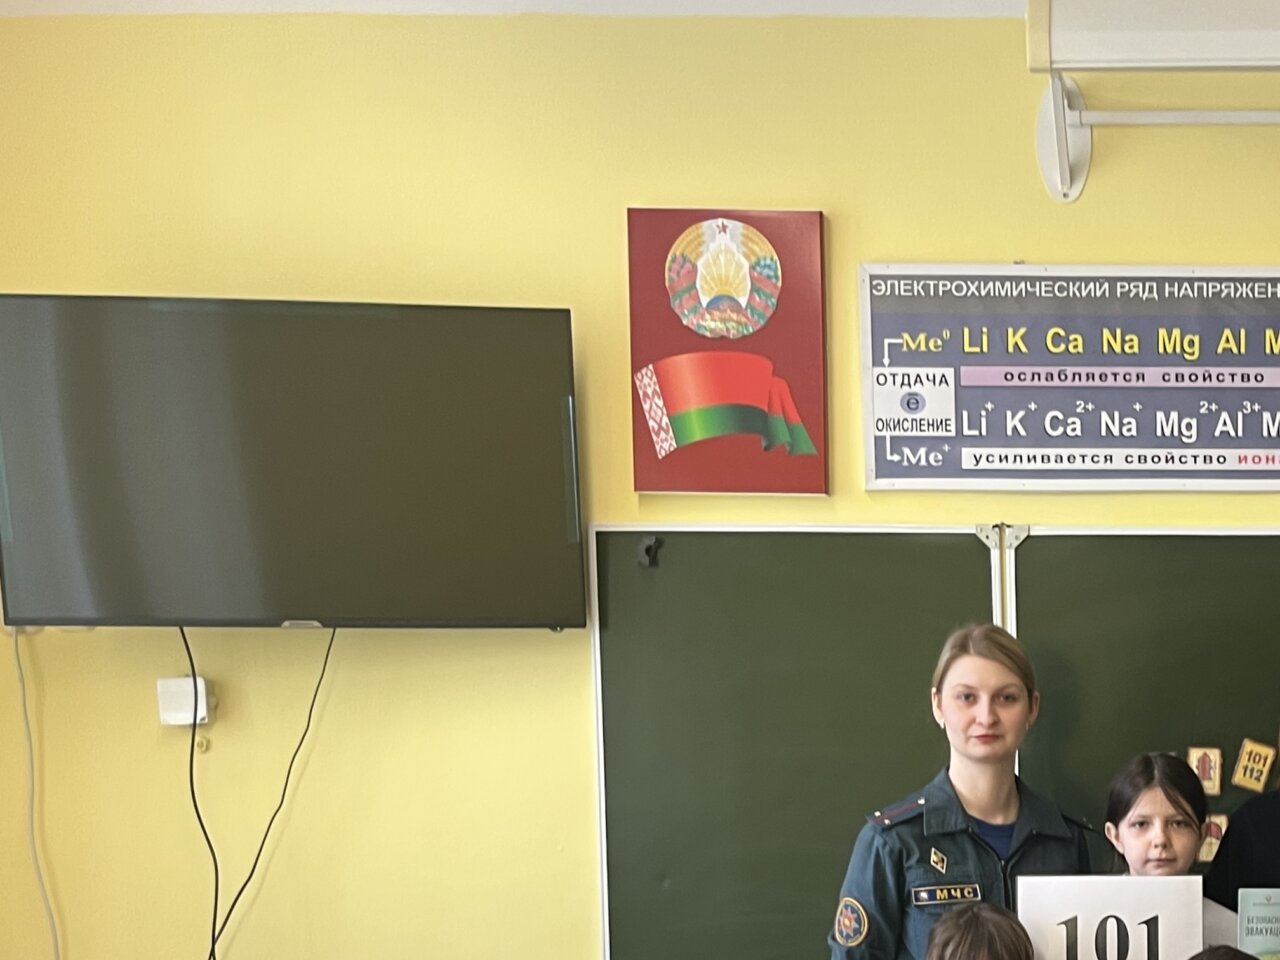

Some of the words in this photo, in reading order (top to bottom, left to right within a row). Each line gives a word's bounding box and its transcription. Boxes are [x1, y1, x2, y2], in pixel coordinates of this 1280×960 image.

[872, 278, 1109, 297] ЭЛЕКТРОХИМИЧЕСКИЙ
[1116, 281, 1158, 301] РЯД
[962, 326, 988, 353] Li
[1006, 326, 1029, 354] K
[1045, 326, 1084, 354] Ca
[1102, 327, 1140, 355] Na
[1157, 327, 1200, 360] Mg
[1216, 327, 1246, 355] Al
[876, 373, 950, 388] ОТДАЧА
[1003, 369, 1146, 383] ослабляется
[1162, 370, 1266, 384] свойство
[876, 418, 952, 433] ОКИСЛЕНИЕ
[972, 452, 1114, 467] усиливается
[1124, 452, 1227, 466] свойство
[1246, 749, 1269, 768] 101
[1242, 764, 1264, 783] 112
[936, 888, 974, 900] МЧС
